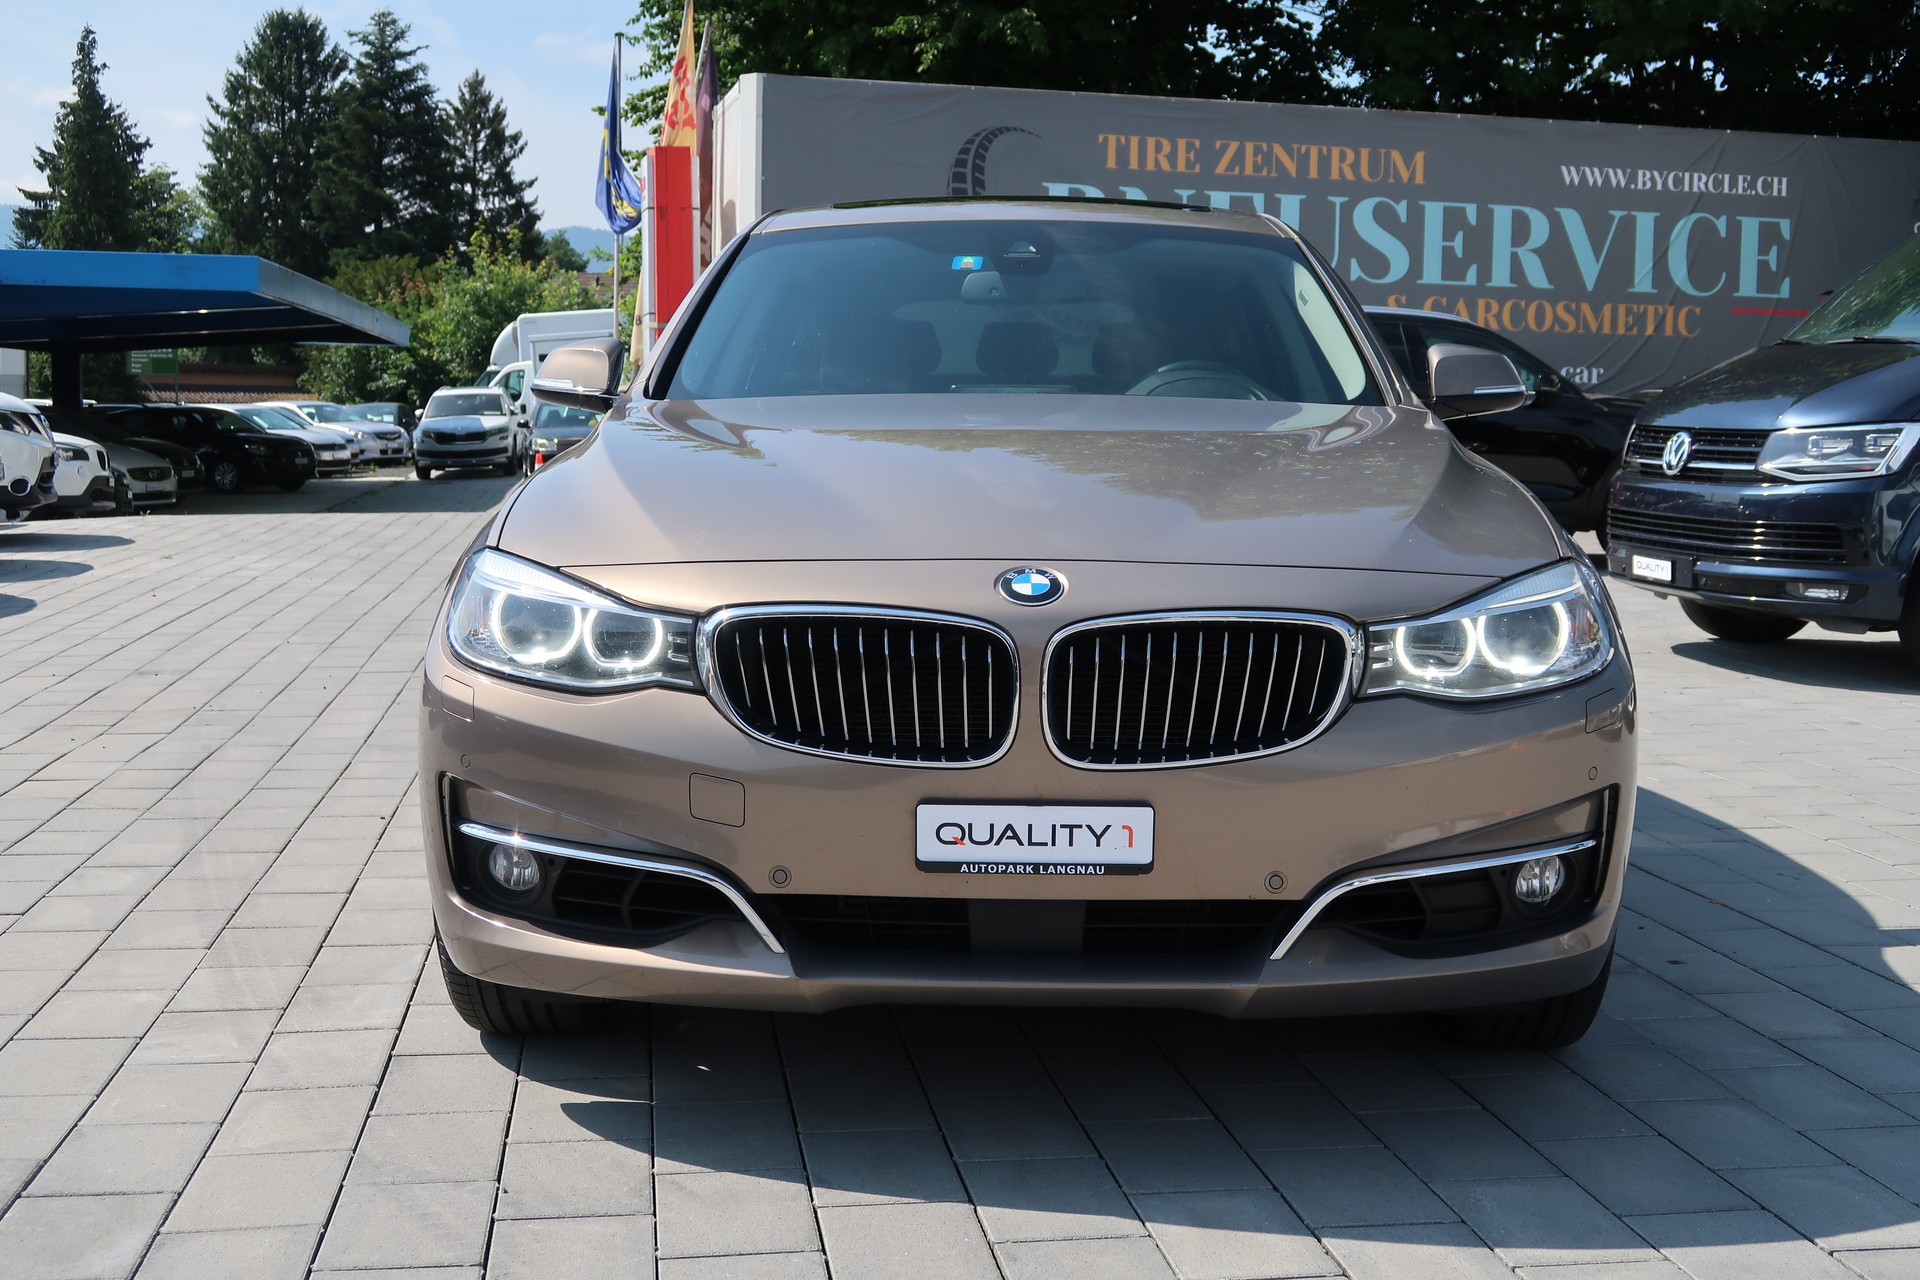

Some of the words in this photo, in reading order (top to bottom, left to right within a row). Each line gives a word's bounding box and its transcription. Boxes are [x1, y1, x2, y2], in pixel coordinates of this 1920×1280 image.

[1098, 134, 1201, 174] TIRE
[1215, 141, 1427, 185] ZENTRUM
[1560, 164, 1789, 198] WWW.BYCIRCLE.CH
[1041, 181, 1791, 299] USERVICE
[1005, 568, 1057, 580] BMW
[935, 822, 1113, 848] QUALITY
[1121, 824, 1134, 848] 1
[960, 863, 1034, 874] AUTOPARK
[1039, 864, 1106, 876] LANGNAU
